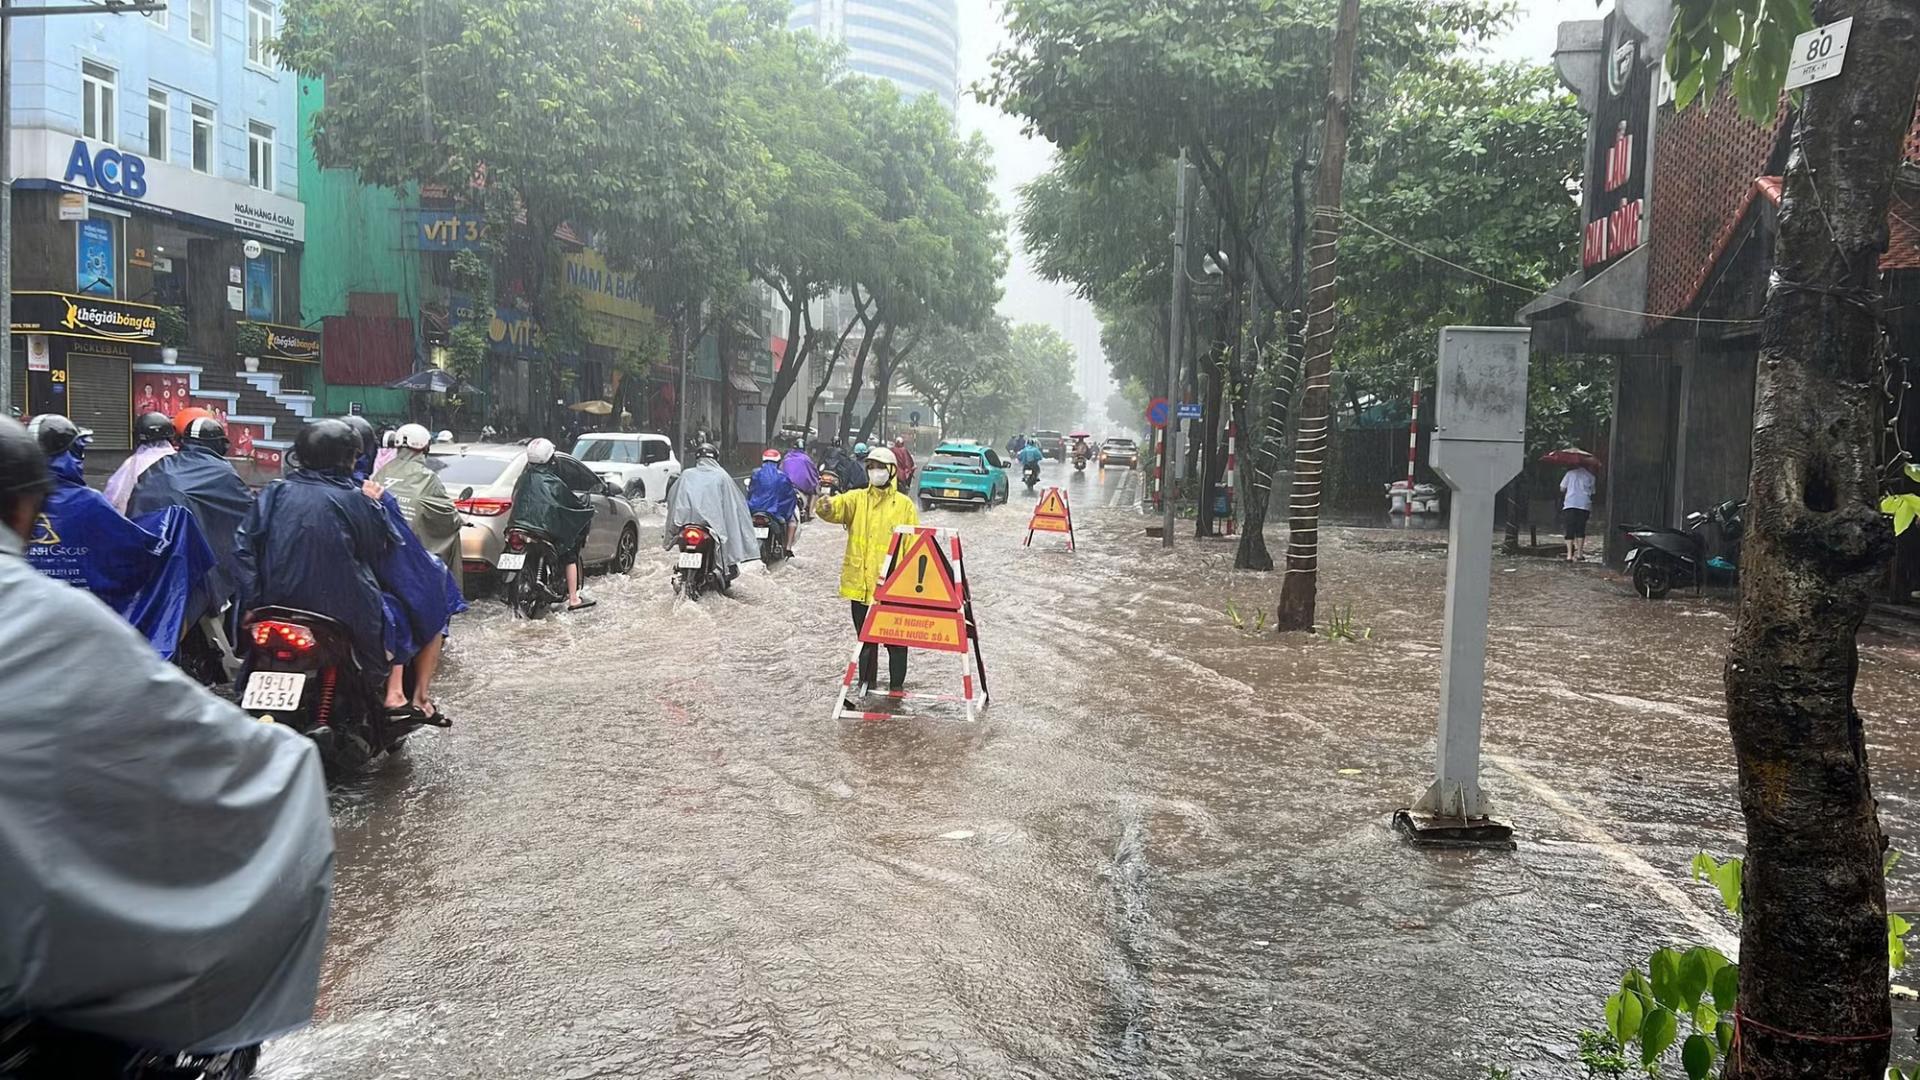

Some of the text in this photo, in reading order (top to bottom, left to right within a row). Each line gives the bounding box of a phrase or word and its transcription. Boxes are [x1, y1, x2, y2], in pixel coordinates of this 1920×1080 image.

[1807, 34, 1832, 61] 80
[64, 139, 147, 199] ACB
[245, 245, 259, 253] ATM
[1584, 216, 1608, 268] CUA
[567, 260, 601, 293] NAM
[616, 274, 641, 303] BAN
[52, 369, 65, 382] 29
[258, 675, 295, 691] 19-L1
[249, 691, 295, 707] 145.54
